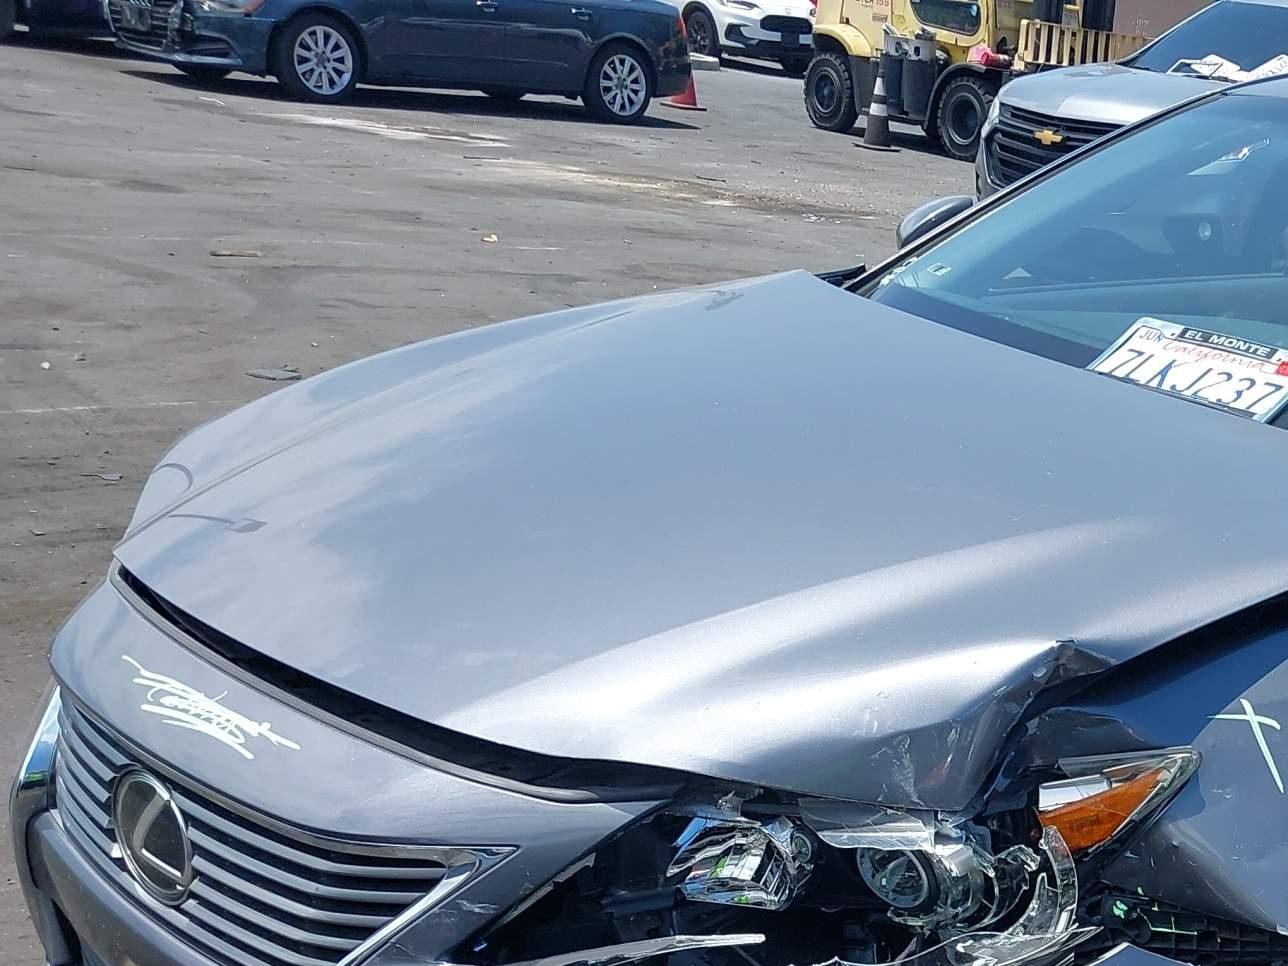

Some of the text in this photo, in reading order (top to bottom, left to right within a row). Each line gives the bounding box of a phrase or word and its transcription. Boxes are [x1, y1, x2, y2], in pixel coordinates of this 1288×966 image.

[1138, 329, 1165, 343] JUN
[1183, 329, 1271, 358] EL MONTE
[1161, 339, 1270, 375] California
[1107, 348, 1285, 411] 7LKJ237
